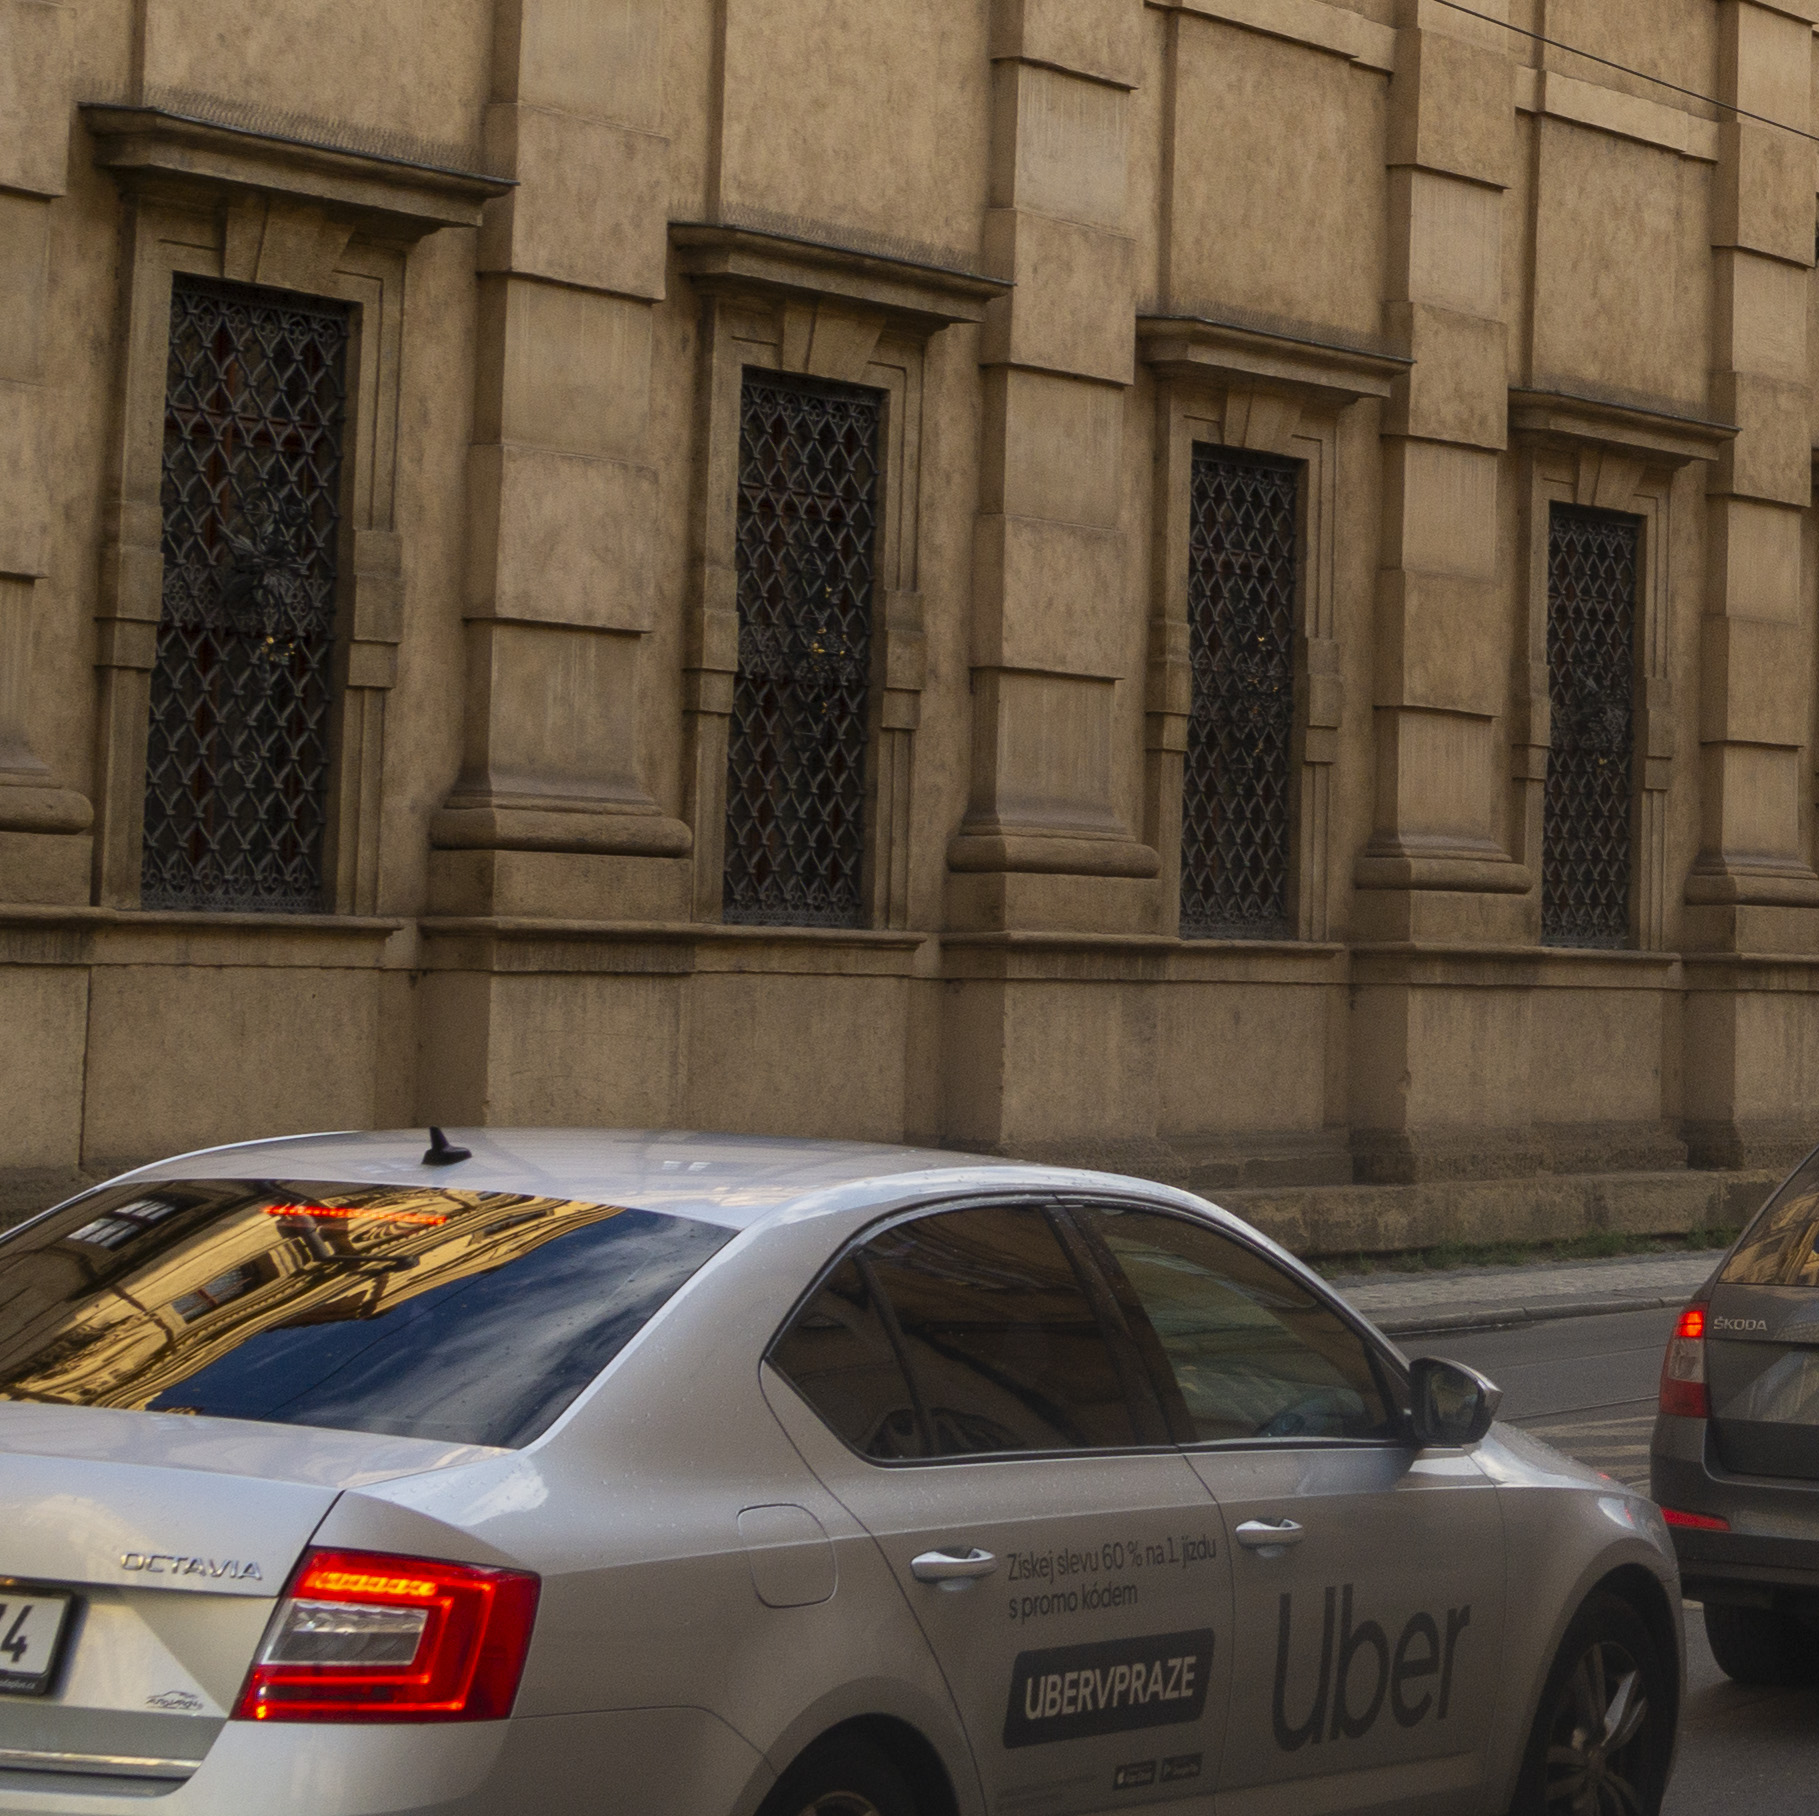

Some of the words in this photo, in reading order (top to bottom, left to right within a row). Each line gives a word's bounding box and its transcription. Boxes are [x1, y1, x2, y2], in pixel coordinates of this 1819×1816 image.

[1713, 1315, 1768, 1330] ŠKODA
[121, 1552, 263, 1580] OCTAVIA
[1006, 1549, 1054, 1584] Získej
[1058, 1548, 1099, 1576] slevu
[1102, 1542, 1125, 1570] 60
[1128, 1540, 1142, 1567] %
[1146, 1544, 1164, 1565] na
[1181, 1534, 1217, 1568] jízdu
[1009, 1598, 1017, 1620] s
[1020, 1590, 1078, 1624] promo
[1081, 1581, 1138, 1609] kódem
[0, 1604, 32, 1662] 4
[1025, 1656, 1197, 1719] UBERVPRAZE
[1272, 1584, 1471, 1752] Uber
